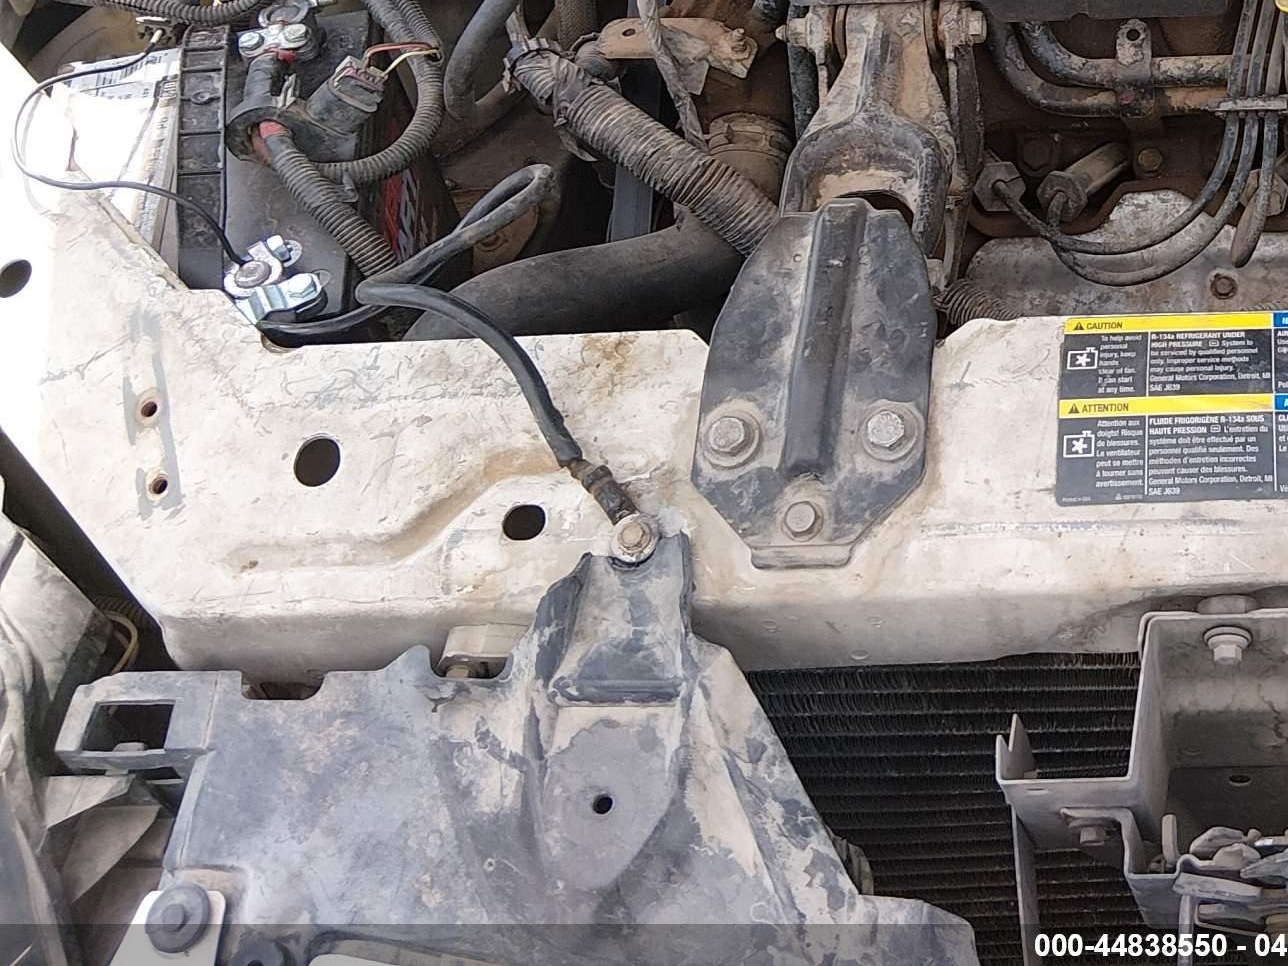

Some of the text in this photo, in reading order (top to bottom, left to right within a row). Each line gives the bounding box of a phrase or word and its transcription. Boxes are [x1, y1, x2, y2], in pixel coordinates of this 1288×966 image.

[1086, 321, 1122, 329] CAUTION
[1221, 339, 1244, 347] System
[1227, 347, 1257, 355] personnel
[1081, 403, 1128, 412] ATTENTION
[1149, 447, 1180, 455] personnel
[1199, 475, 1237, 484] Corporation,
